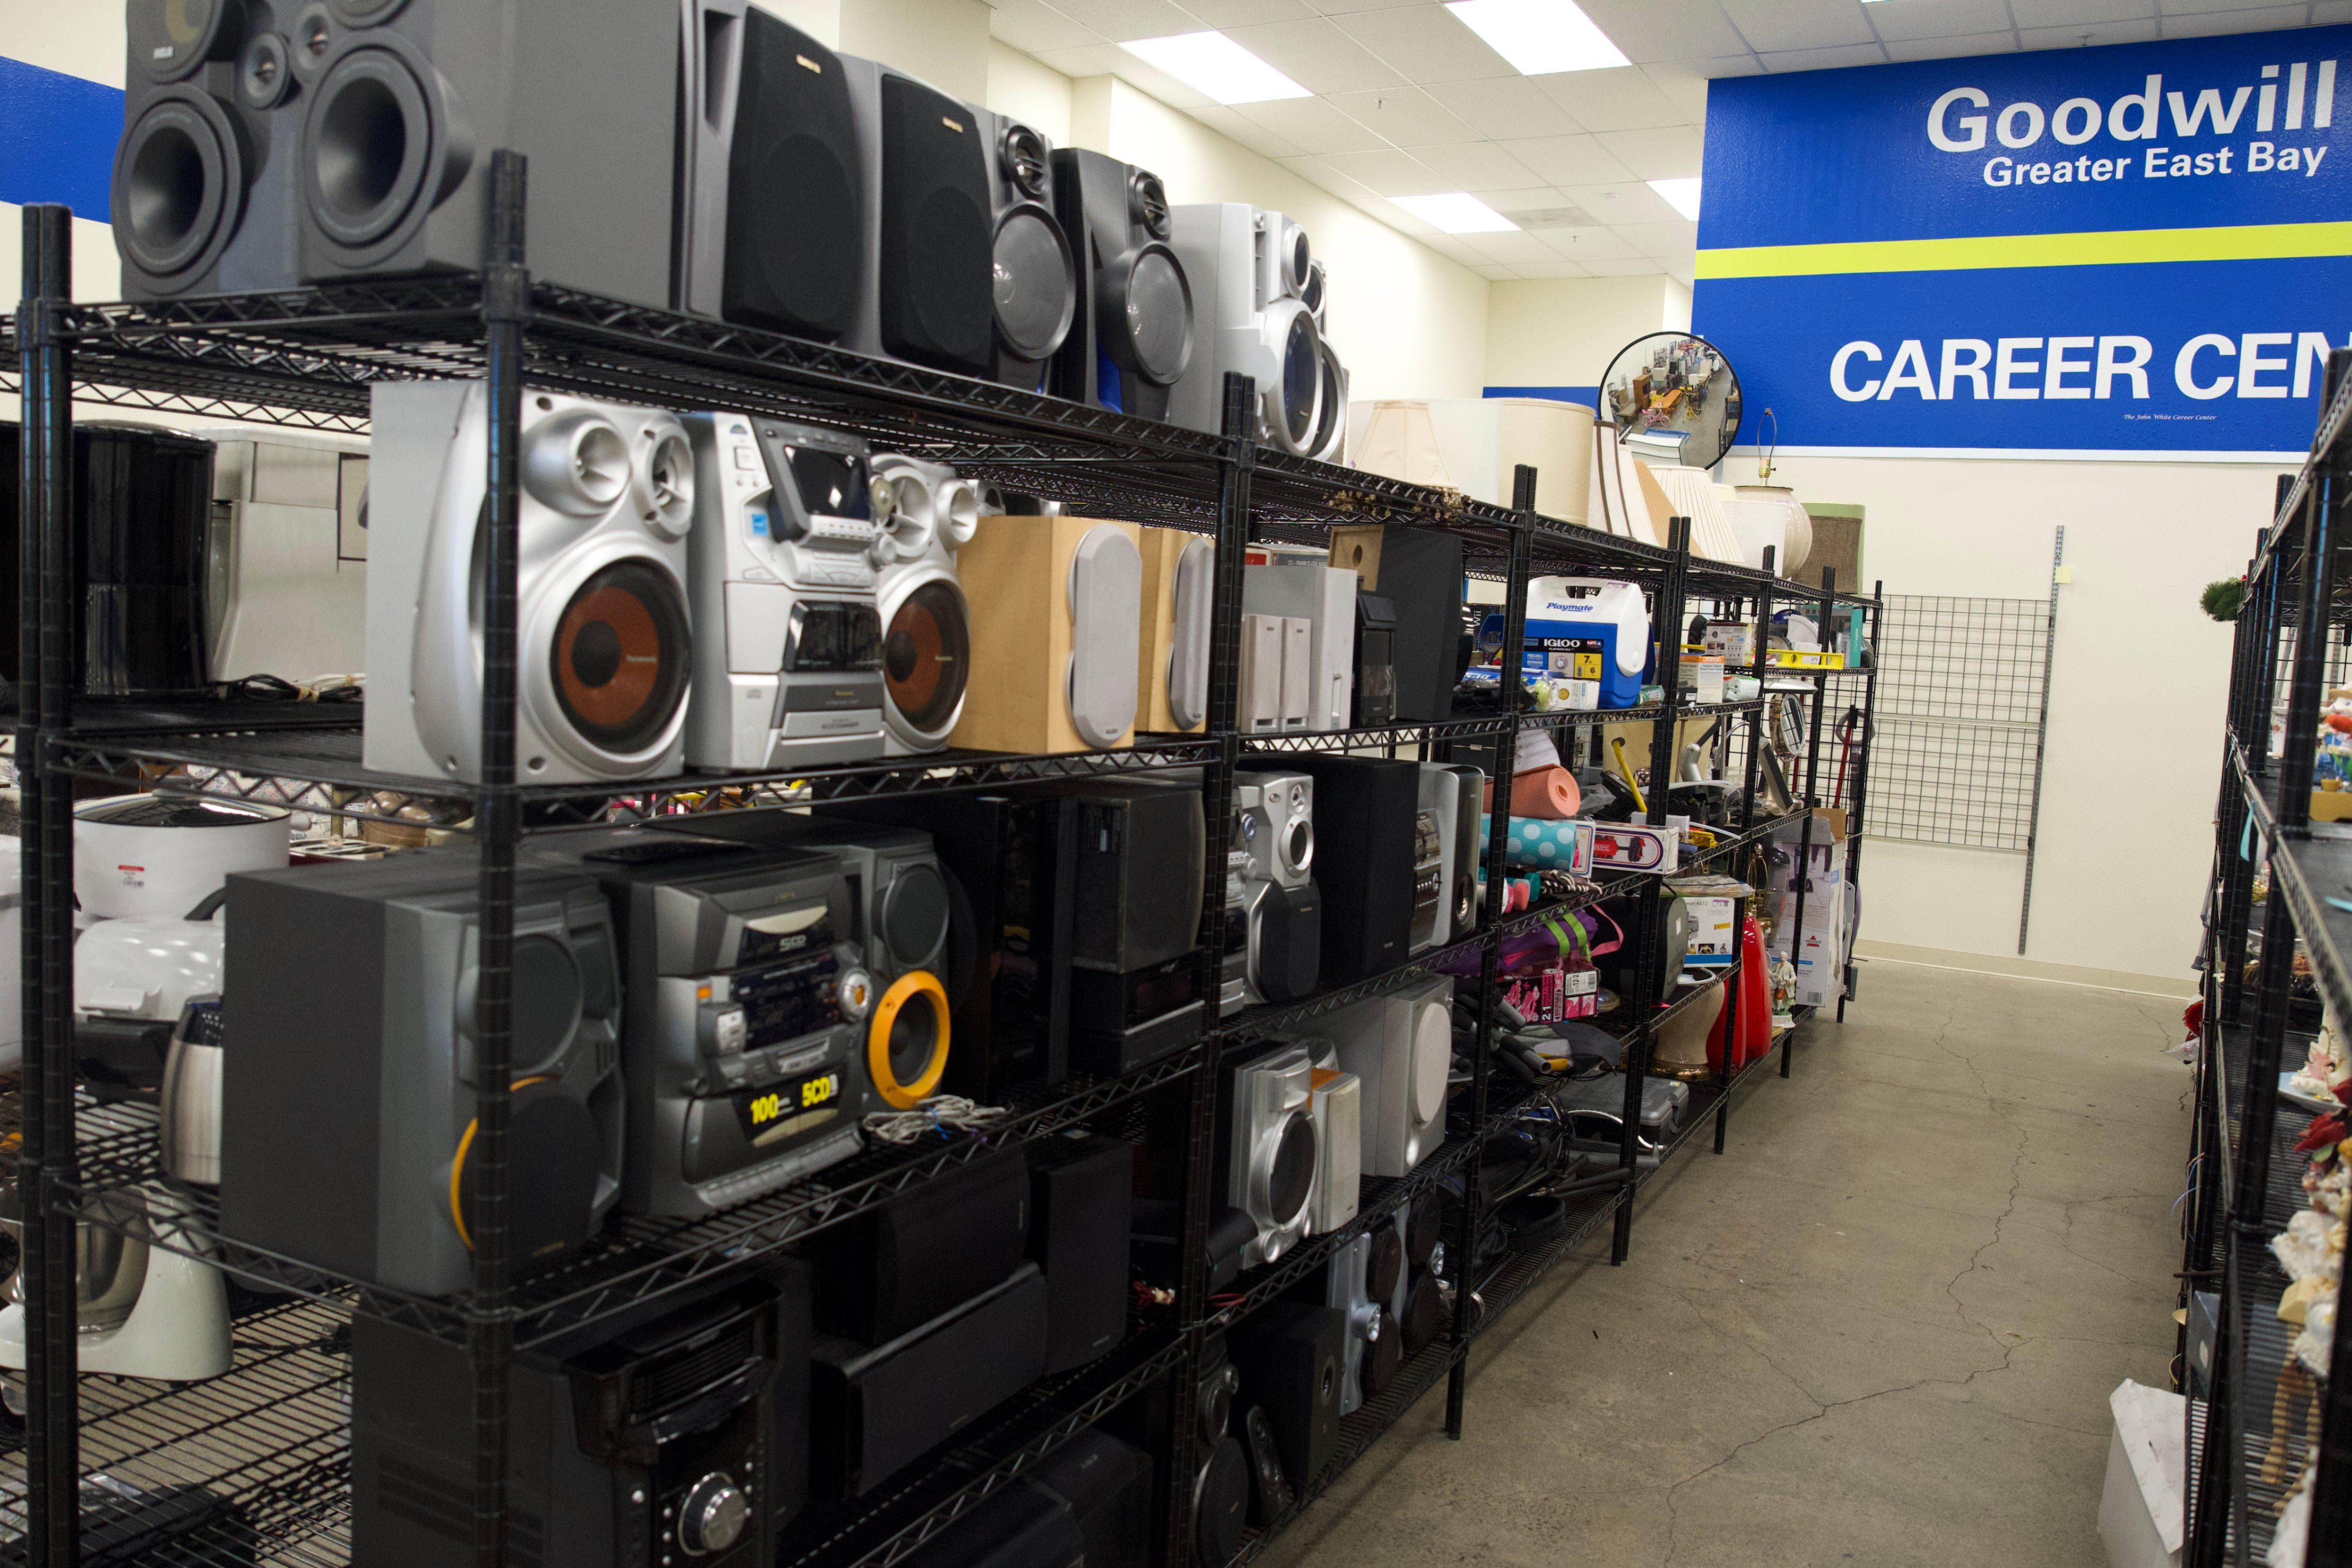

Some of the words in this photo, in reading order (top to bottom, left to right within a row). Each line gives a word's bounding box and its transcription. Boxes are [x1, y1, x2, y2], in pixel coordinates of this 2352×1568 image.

[1927, 60, 2336, 153] Goodwill
[1983, 155, 2131, 187] Greater
[2145, 146, 2234, 178] East
[2248, 141, 2328, 177] Bay
[1830, 335, 2153, 402] CAREER
[1473, 610, 1481, 627] Wii
[1546, 602, 1593, 611] Playmate
[1543, 638, 1580, 648] IGLOO
[1584, 655, 1590, 663] 7
[750, 1093, 779, 1125] 100
